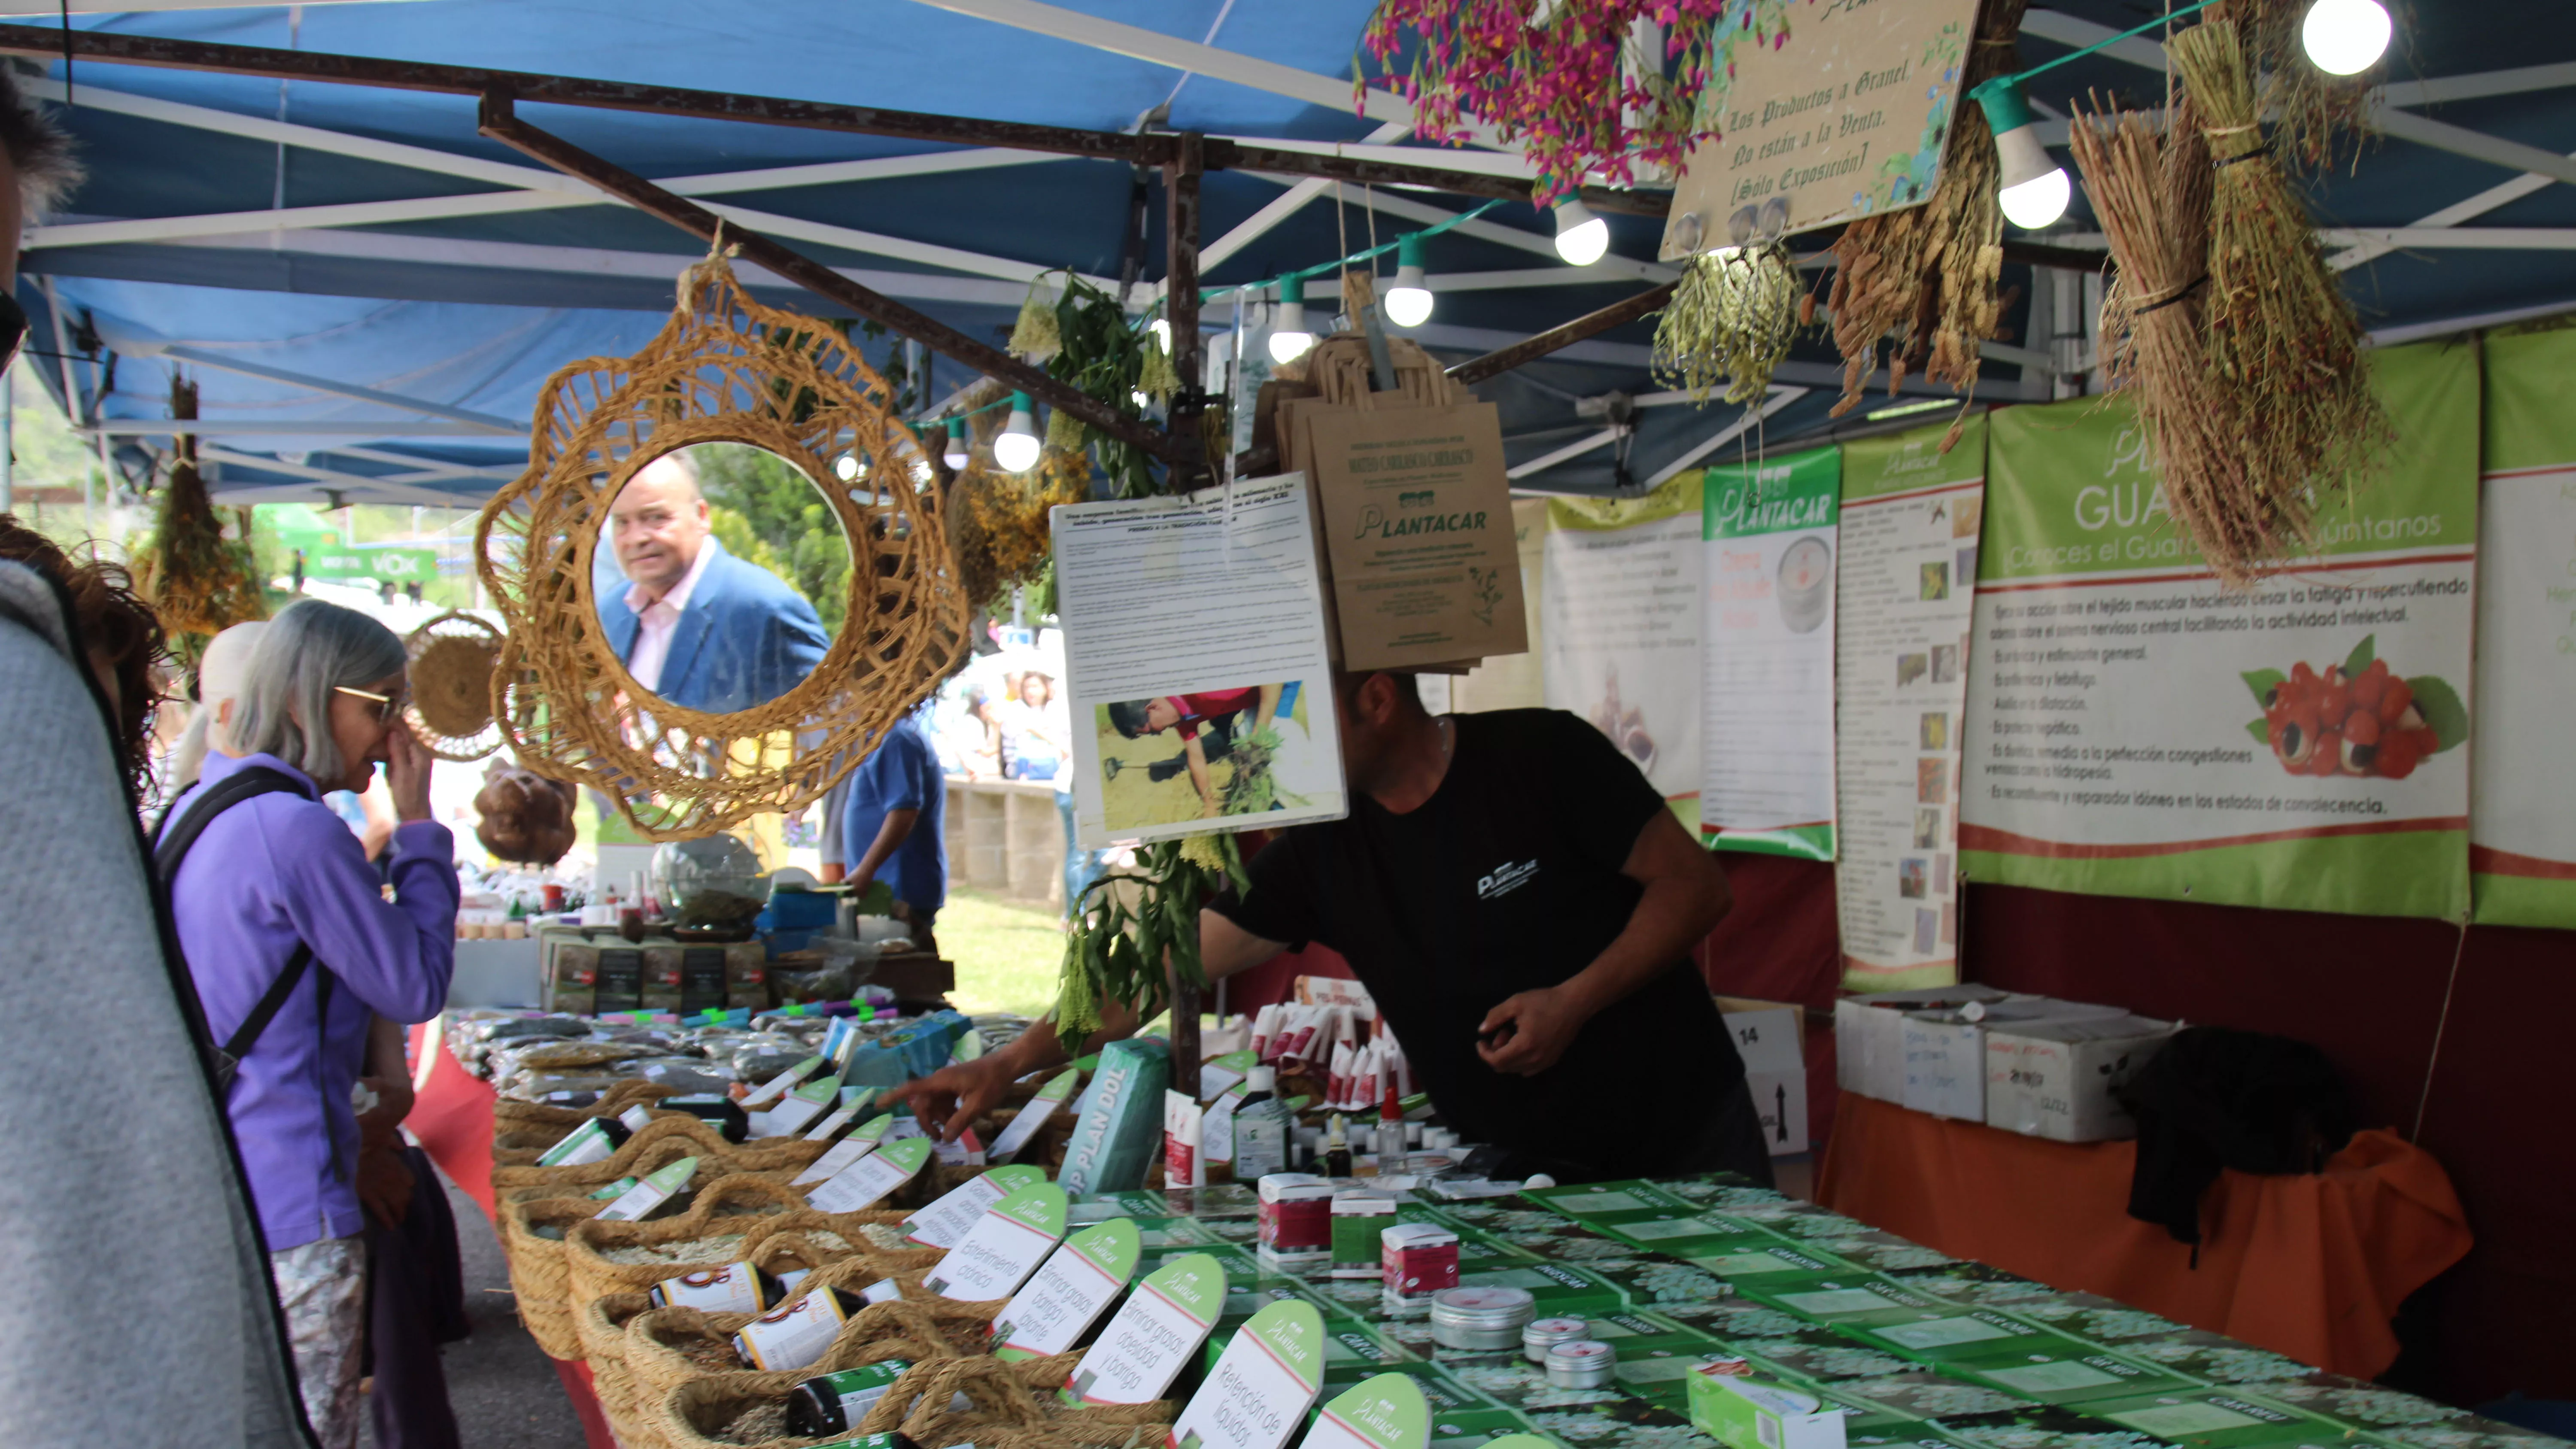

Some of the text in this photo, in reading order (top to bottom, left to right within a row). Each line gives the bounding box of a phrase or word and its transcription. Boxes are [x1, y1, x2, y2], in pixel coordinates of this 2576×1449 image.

[1728, 58, 1910, 133] Los Productos a Granel,
[1729, 109, 1886, 170] No están a la Venta.
[1354, 503, 1488, 540] PLANTACAR
[371, 552, 420, 575] VOX
[2291, 588, 2304, 604] la
[2308, 585, 2352, 606] fatiga
[2141, 617, 2181, 635] central
[2251, 613, 2265, 629] la
[2267, 608, 2337, 628] actividad
[2341, 605, 2410, 626] intelectual.
[2168, 747, 2252, 766] congestiones
[2178, 794, 2192, 808] en
[2195, 792, 2214, 808] los
[2216, 793, 2264, 811] estados
[2267, 796, 2282, 811] de
[2284, 796, 2388, 816] convalecencia.
[1739, 1027, 1759, 1046] 14
[1075, 1111, 1110, 1171] PLAN
[1097, 1068, 1128, 1109] DOL
[956, 1264, 994, 1289] crónico
[960, 1239, 1020, 1277] Estreñimiento
[1121, 1298, 1186, 1357] Eliminar grasas,
[1266, 1317, 1308, 1364] PLANTACAR
[1116, 1331, 1163, 1369] obesidad
[1106, 1354, 1142, 1391] barriga
[1217, 1362, 1282, 1436] Retención de
[1212, 1398, 1252, 1447] líquidos
[1352, 1397, 1404, 1443] PLANTACAR
